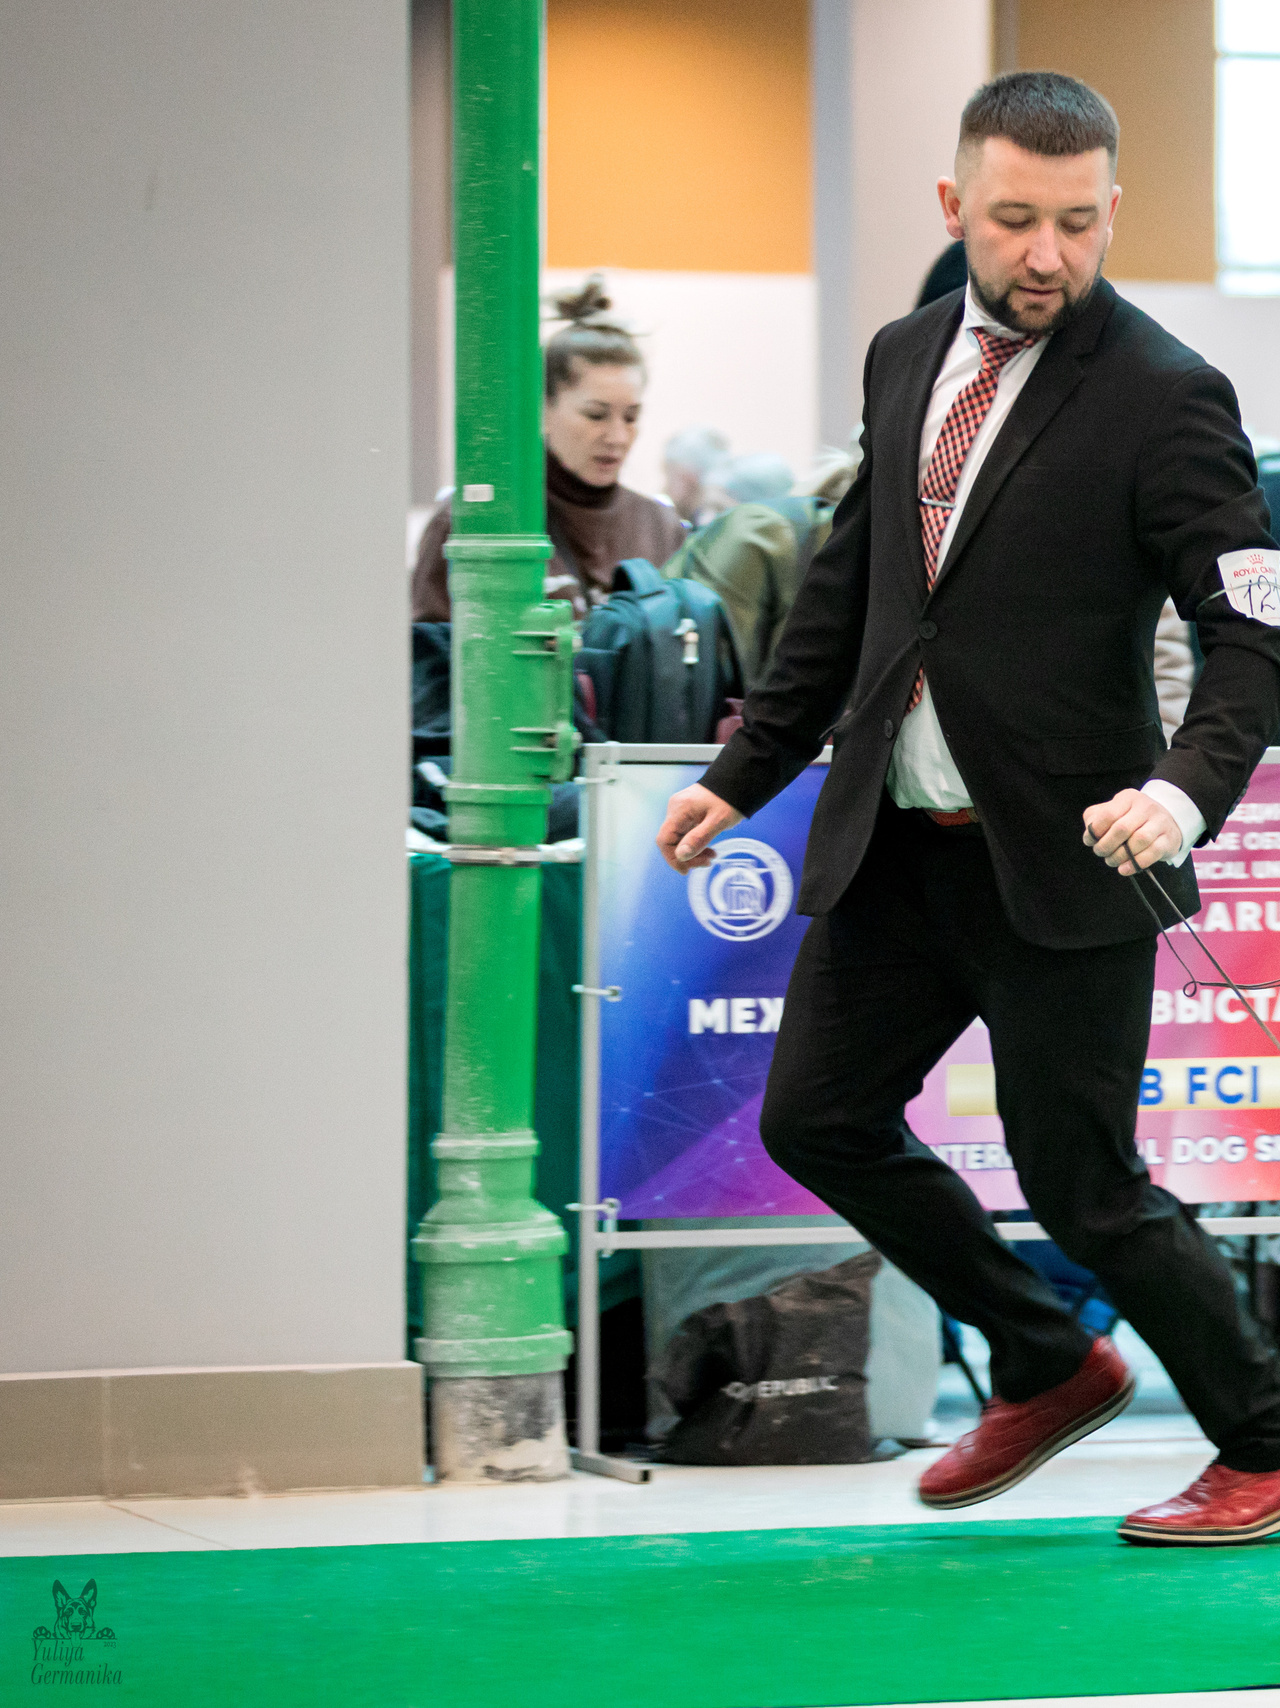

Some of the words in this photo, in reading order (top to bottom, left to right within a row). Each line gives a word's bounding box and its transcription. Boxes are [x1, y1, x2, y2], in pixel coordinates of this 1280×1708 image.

[1233, 567, 1259, 578] ROYAL
[1187, 1065, 1260, 1105] FCI
[1172, 1136, 1248, 1164] DOG
